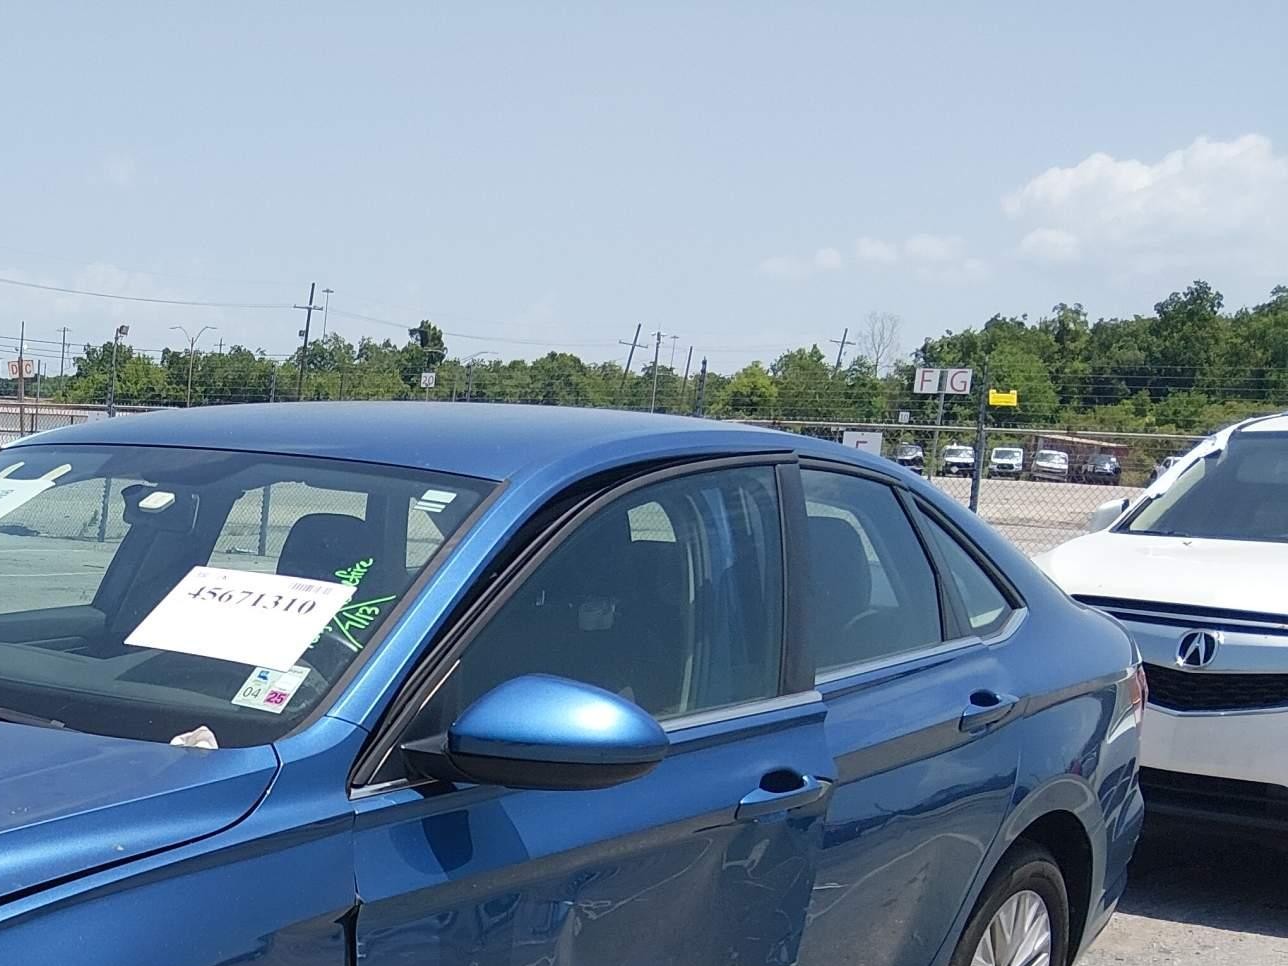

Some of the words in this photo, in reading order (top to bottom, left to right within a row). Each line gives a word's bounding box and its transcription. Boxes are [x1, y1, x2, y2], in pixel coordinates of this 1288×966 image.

[11, 364, 18, 375] D
[24, 363, 32, 374] C
[920, 370, 934, 391] F
[950, 370, 968, 392] G
[187, 586, 317, 615] 45671310
[242, 686, 262, 699] 04
[264, 690, 288, 705] 25
